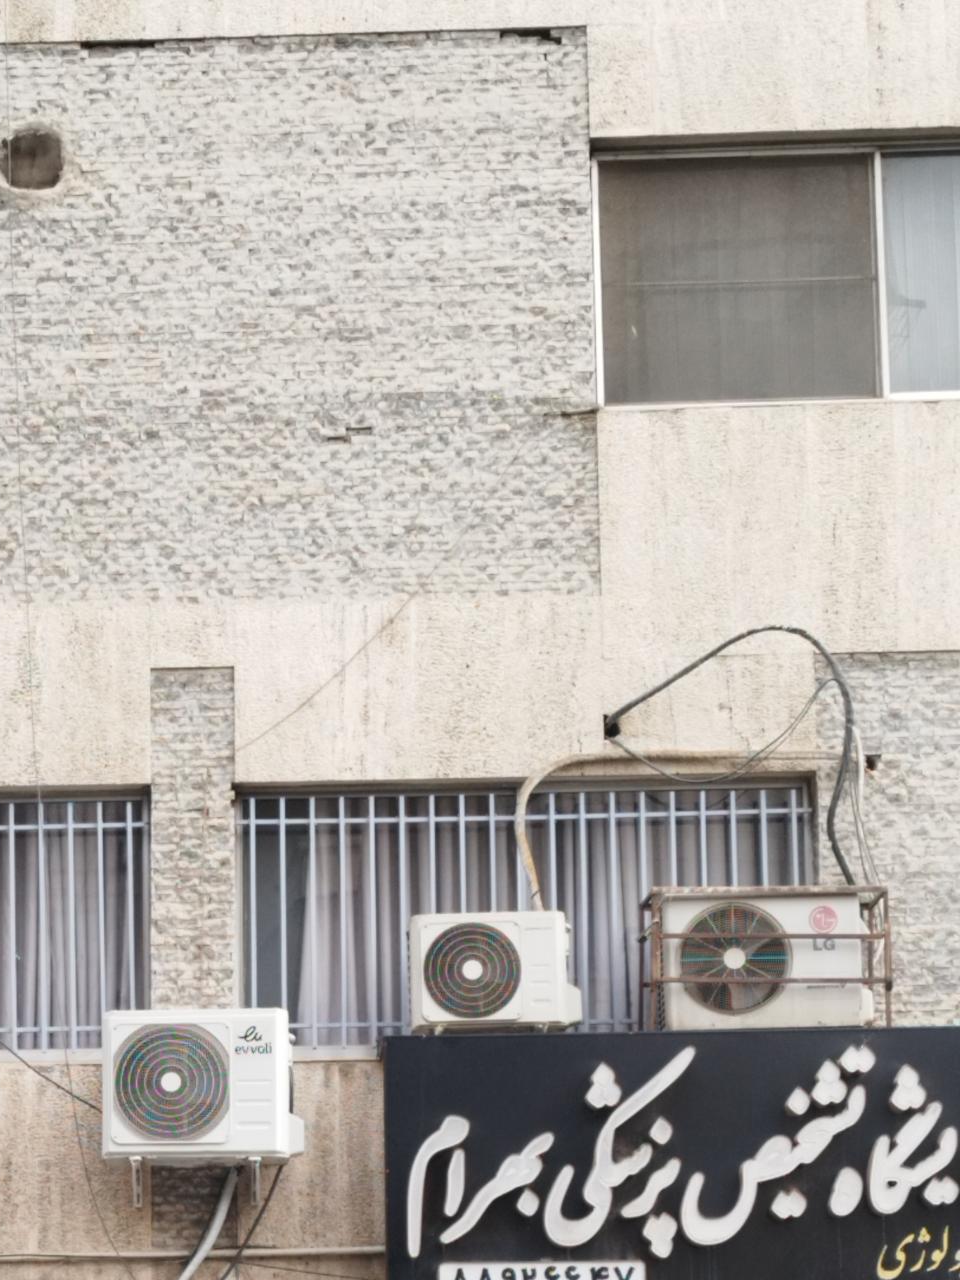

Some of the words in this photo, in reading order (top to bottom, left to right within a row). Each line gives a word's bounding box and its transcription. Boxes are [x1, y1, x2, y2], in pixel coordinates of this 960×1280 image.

[406, 1113, 556, 1259] بهرام
[543, 1045, 697, 1260] پزشکی
[680, 1043, 877, 1248] تشخیص
[828, 1063, 960, 1218] یشگاه
